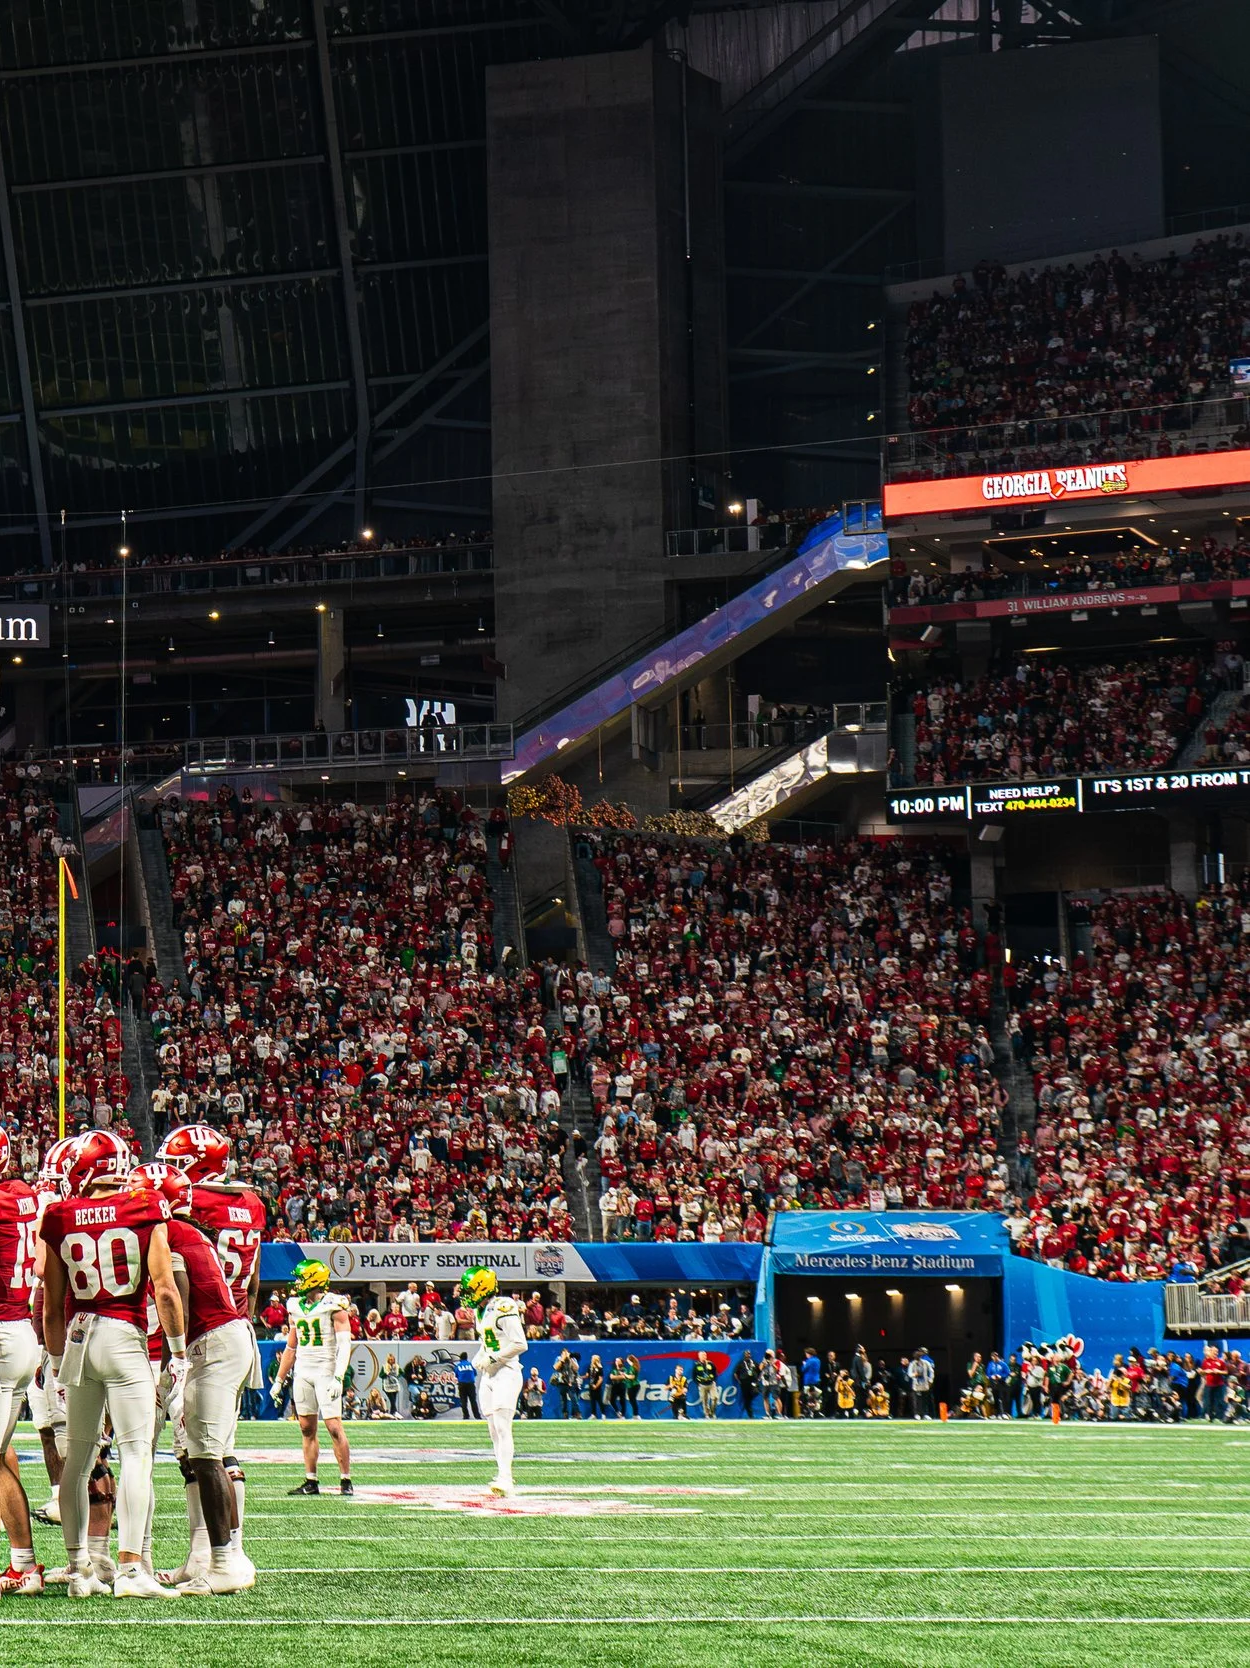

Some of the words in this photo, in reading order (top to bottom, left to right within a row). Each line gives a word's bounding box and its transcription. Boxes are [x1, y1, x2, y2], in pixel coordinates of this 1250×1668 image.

[982, 472, 1052, 499] GEORGIA
[1055, 465, 1127, 492] PEANUTS
[1007, 601, 1018, 612] 31
[1023, 598, 1069, 610] WILLIAM
[1072, 592, 1125, 605] ANDREWS
[1094, 780, 1122, 793] IT'S
[1125, 778, 1153, 792] 1ST
[1156, 777, 1168, 790] &
[1171, 775, 1189, 789] 20
[1191, 772, 1238, 787] FROM
[989, 788, 1021, 799] NEED
[1023, 786, 1061, 797] HELP?
[891, 799, 932, 814] 10:00
[938, 796, 965, 811] PM
[974, 801, 1005, 813] TEXT
[1005, 797, 1076, 811] 470-444-0234
[75, 1205, 117, 1226] BECKER
[60, 1227, 142, 1300] 80
[360, 1255, 430, 1267] PLAYOFF
[436, 1254, 521, 1267] SEMIFINAL
[534, 1261, 564, 1270] PEACH
[795, 1253, 908, 1269] Mercedes-Benz
[912, 1254, 975, 1270] Stadium
[296, 1318, 323, 1347] 31
